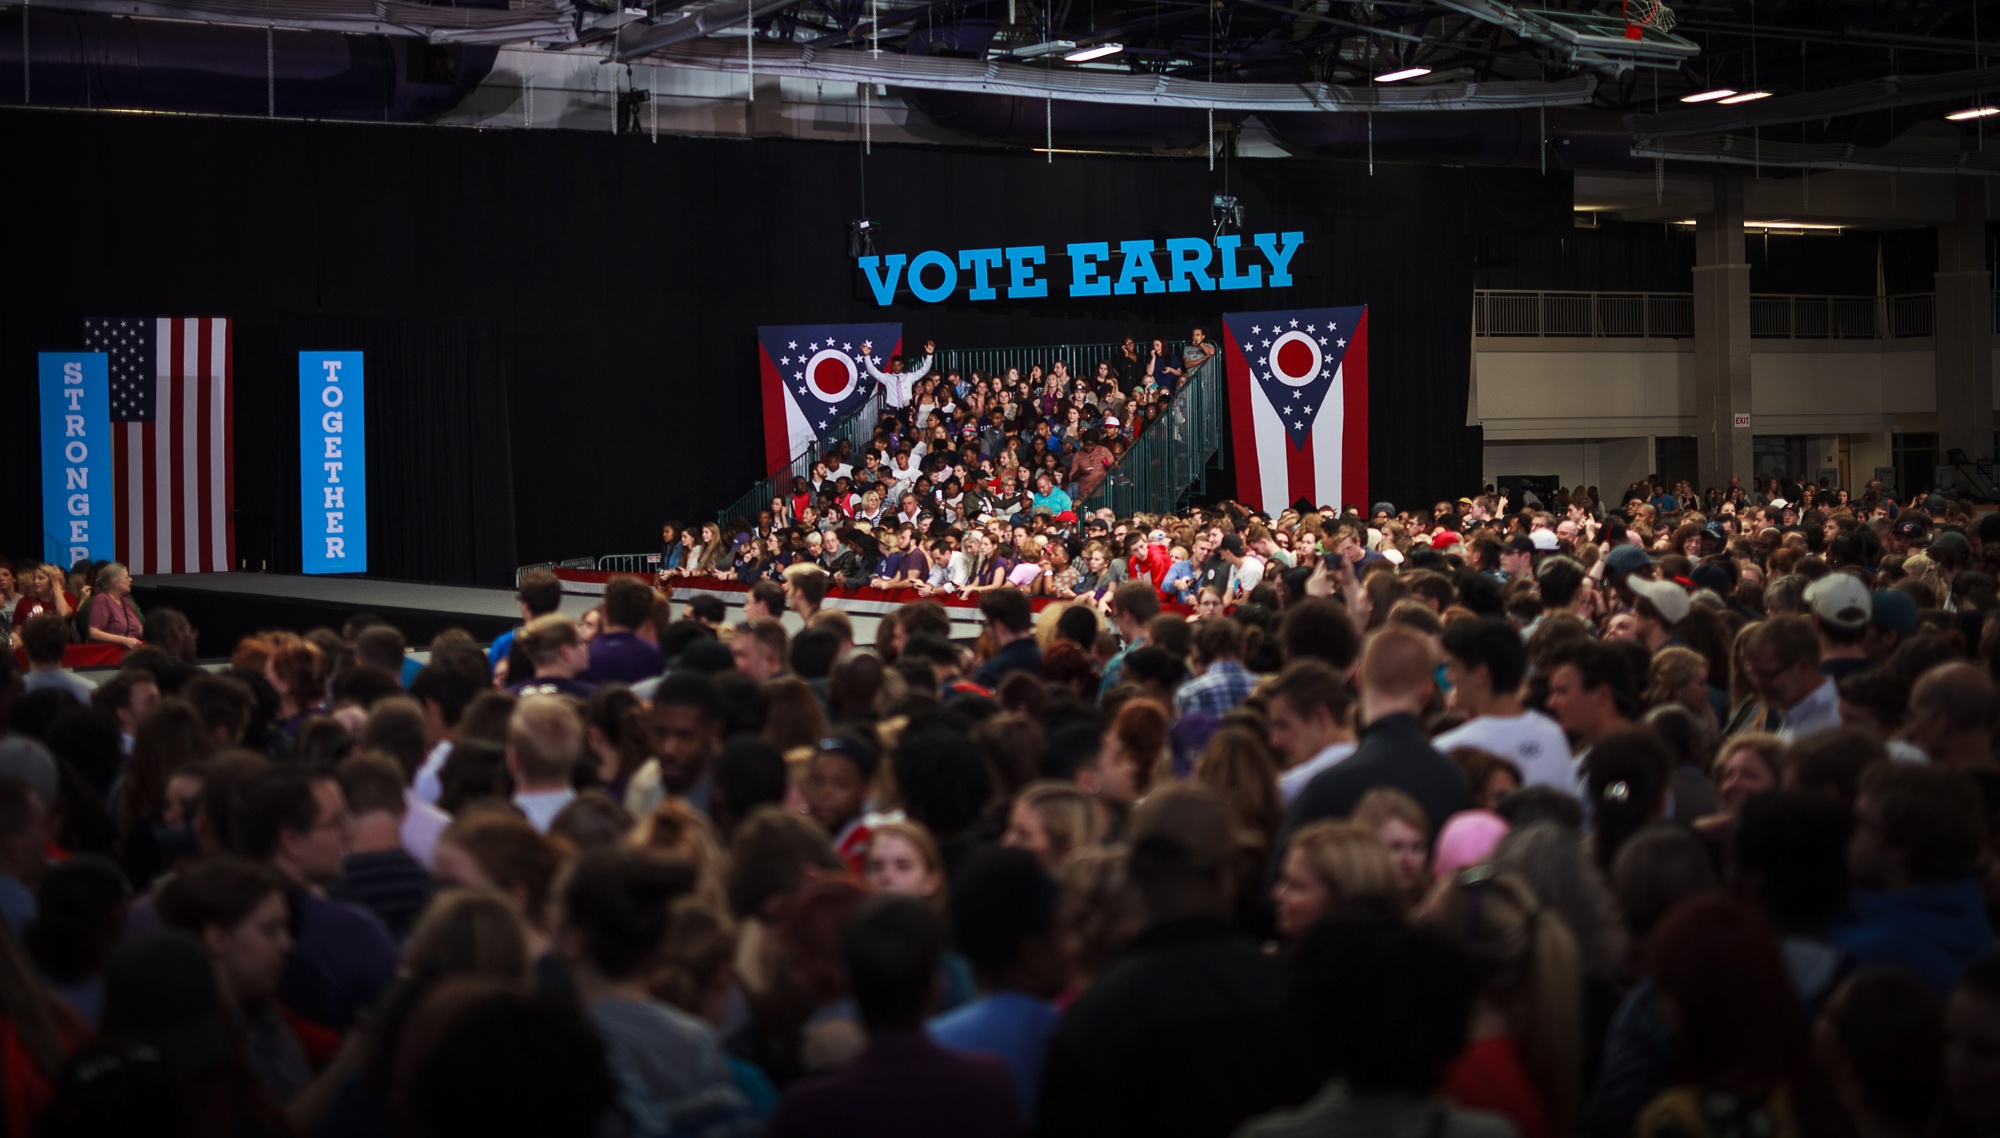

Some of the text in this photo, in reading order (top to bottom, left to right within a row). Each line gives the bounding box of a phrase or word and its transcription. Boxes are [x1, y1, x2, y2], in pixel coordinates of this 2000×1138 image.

[858, 231, 1304, 306] VOTE EARLY
[1735, 416, 1750, 425] EXIT
[321, 360, 346, 558] TOGETHER
